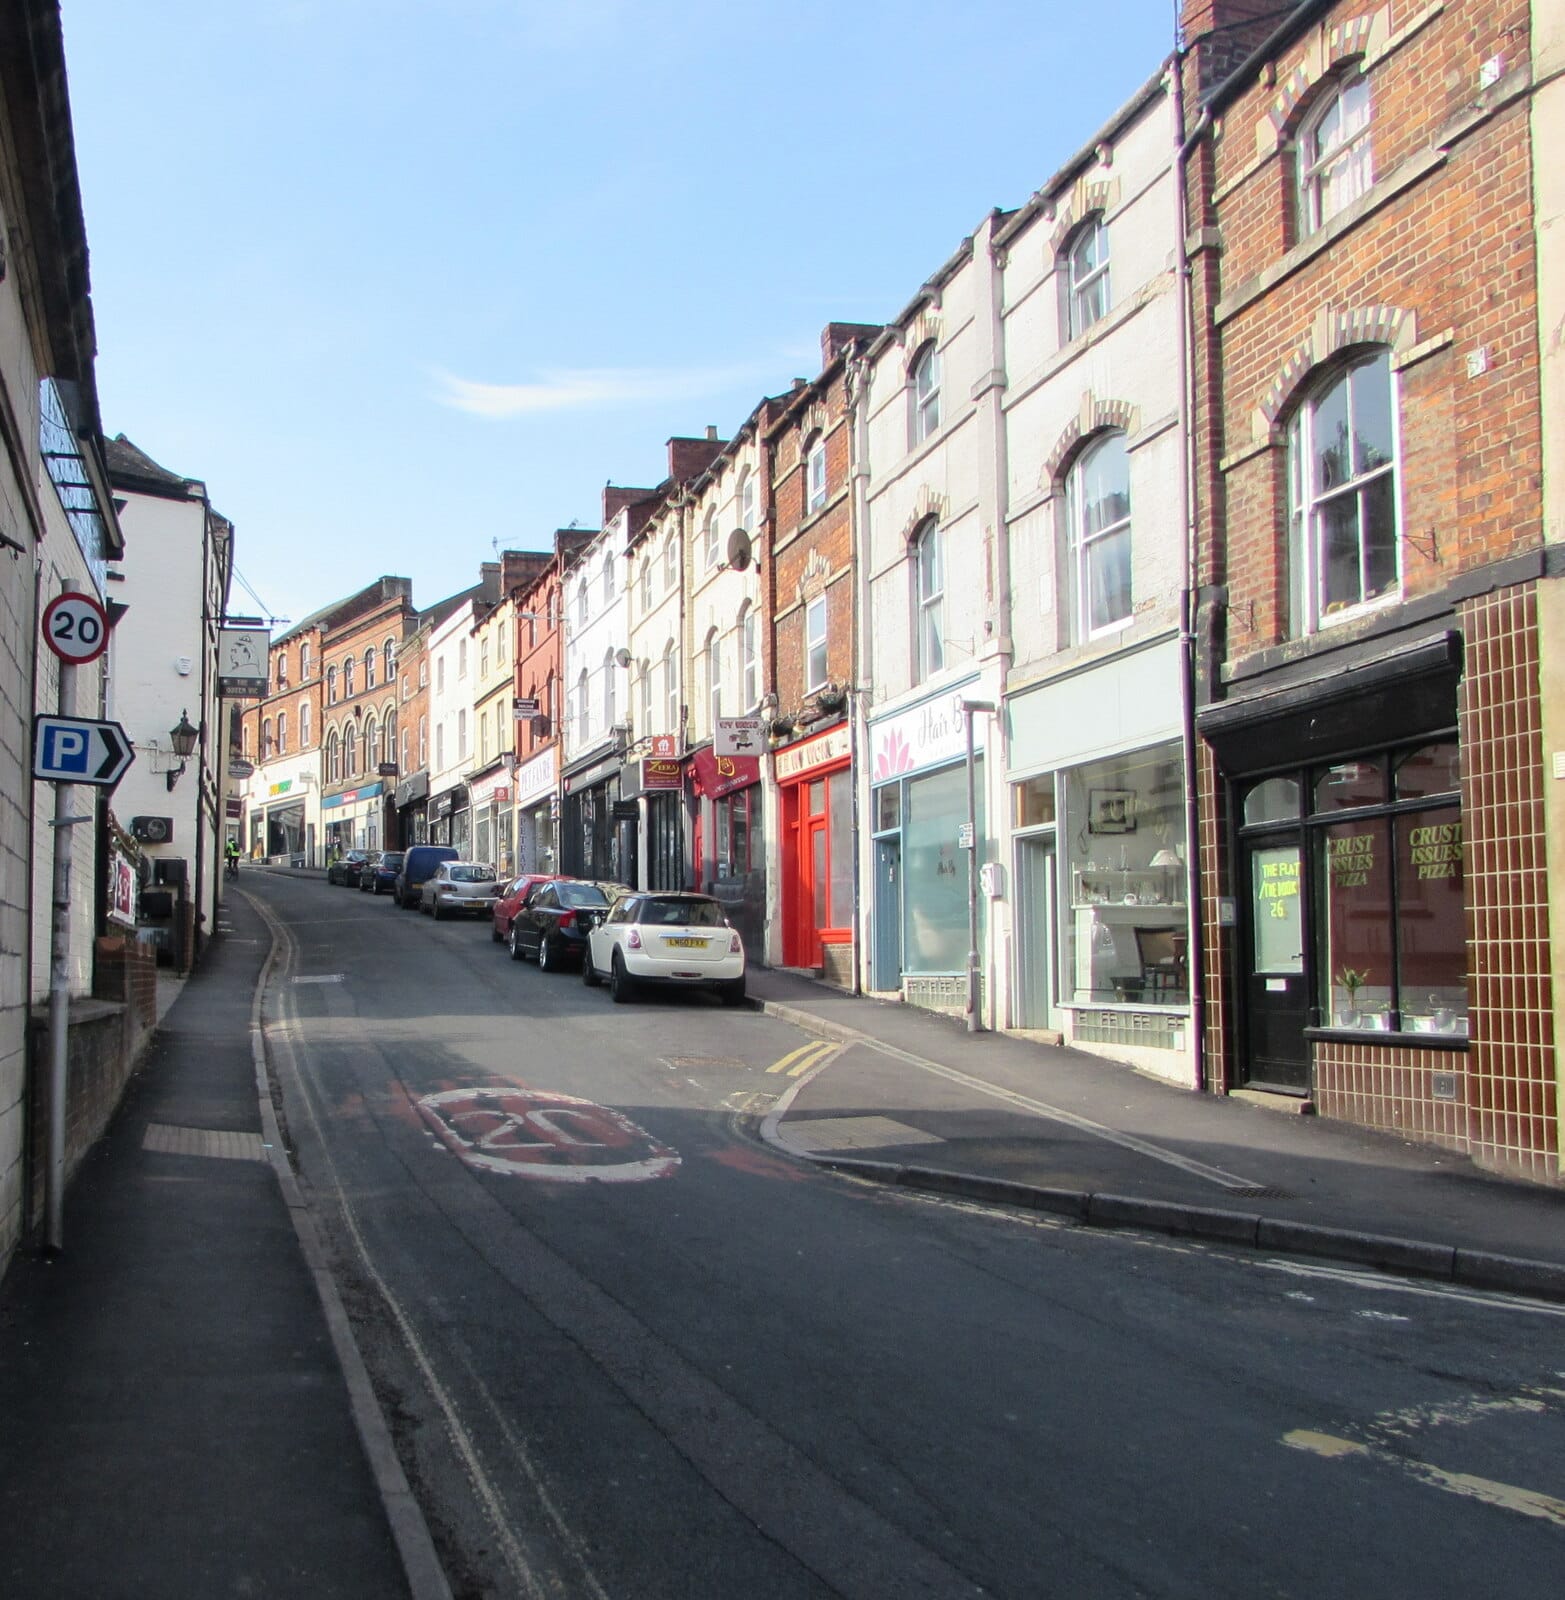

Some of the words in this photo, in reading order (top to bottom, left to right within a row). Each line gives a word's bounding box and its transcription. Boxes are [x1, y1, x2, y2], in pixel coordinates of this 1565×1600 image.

[54, 611, 99, 644] 20
[53, 731, 83, 768] P
[646, 760, 679, 775] ZEERA
[1409, 823, 1463, 847] CRUST
[1410, 844, 1463, 865] ISSUES
[1262, 864, 1278, 878] THE
[1279, 862, 1301, 877] FLAT
[1418, 863, 1456, 880] PIZZA
[1270, 900, 1285, 918] 26
